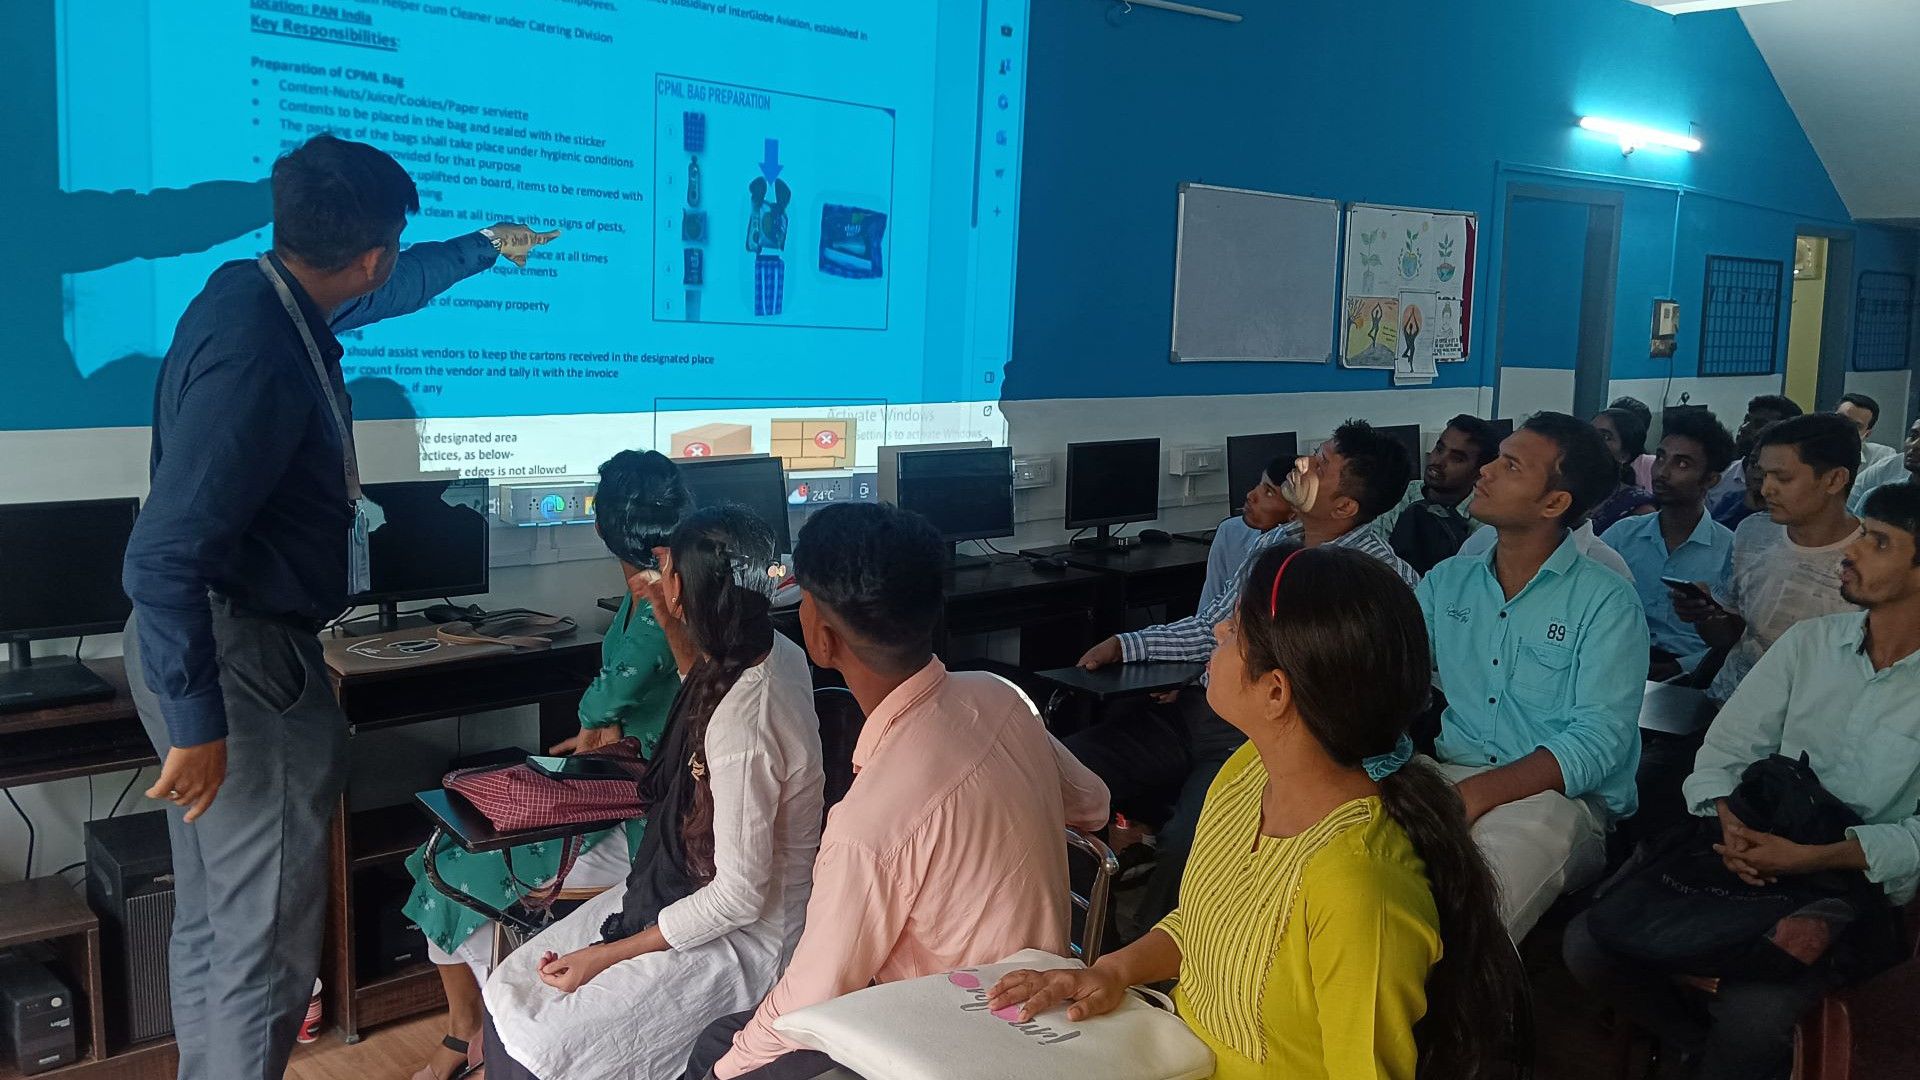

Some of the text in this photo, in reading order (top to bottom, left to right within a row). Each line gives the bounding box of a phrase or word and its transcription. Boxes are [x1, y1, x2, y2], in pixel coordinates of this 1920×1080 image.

[251, 15, 279, 32] Key
[341, 9, 372, 25] India
[424, 5, 447, 16] cum
[450, 6, 491, 23] Cleaner
[495, 16, 526, 29] under
[529, 20, 572, 39] Catering
[574, 27, 613, 44] Division
[717, 5, 727, 14] of
[729, 6, 774, 24] InterGlobe
[776, 15, 812, 31] Aviation,
[814, 23, 859, 40] established
[860, 29, 868, 41] in
[251, 56, 405, 89] Preparation of CPML Bag
[657, 79, 770, 111] CPML BAG PREPARATION
[279, 99, 607, 147] Contents to be placed in the bag and sealed with the sticker
[280, 118, 303, 132] The
[355, 126, 367, 138] of
[370, 127, 389, 140] the
[392, 131, 418, 145] bags
[421, 133, 447, 147] shall
[450, 138, 473, 149] take
[476, 141, 504, 153] place
[507, 145, 538, 157] under
[541, 148, 580, 162] hygienic
[584, 153, 634, 168] conditions
[434, 153, 450, 165] for
[453, 155, 475, 167] that
[478, 159, 521, 172] purpose
[418, 171, 460, 184] uplifted
[463, 176, 477, 185] on
[480, 177, 514, 190] board,
[517, 181, 545, 193] items
[548, 183, 559, 193] to
[561, 185, 574, 195] be
[576, 188, 619, 200] removed
[622, 192, 643, 201] with
[425, 206, 454, 218] clean
[457, 209, 467, 219] at
[471, 209, 483, 220] all
[517, 214, 540, 226] with
[543, 217, 556, 227] no
[560, 218, 582, 231] signs
[585, 220, 595, 230] of
[556, 251, 566, 261] at
[568, 251, 579, 262] all
[582, 252, 608, 264] times
[440, 298, 450, 306] of
[453, 299, 502, 311] company
[505, 301, 549, 312] property
[346, 346, 715, 365] should assist vendors to keep the cartons received in the designated place
[359, 365, 391, 376] count
[395, 364, 422, 375] from
[425, 364, 444, 376] the
[446, 366, 484, 377] vendor
[486, 366, 506, 377] and
[509, 366, 530, 379] tally
[533, 368, 540, 378] it
[542, 368, 564, 378] with
[567, 368, 583, 378] the
[586, 368, 619, 379] invoice
[412, 383, 443, 395] if any
[827, 407, 935, 421] Activate Windows
[434, 433, 491, 445] designated
[494, 433, 517, 443] area
[465, 452, 475, 460] as
[465, 466, 495, 478] edges
[498, 466, 506, 476] is
[509, 466, 526, 476] not
[528, 464, 567, 475] allowed
[1547, 623, 1566, 642] 89
